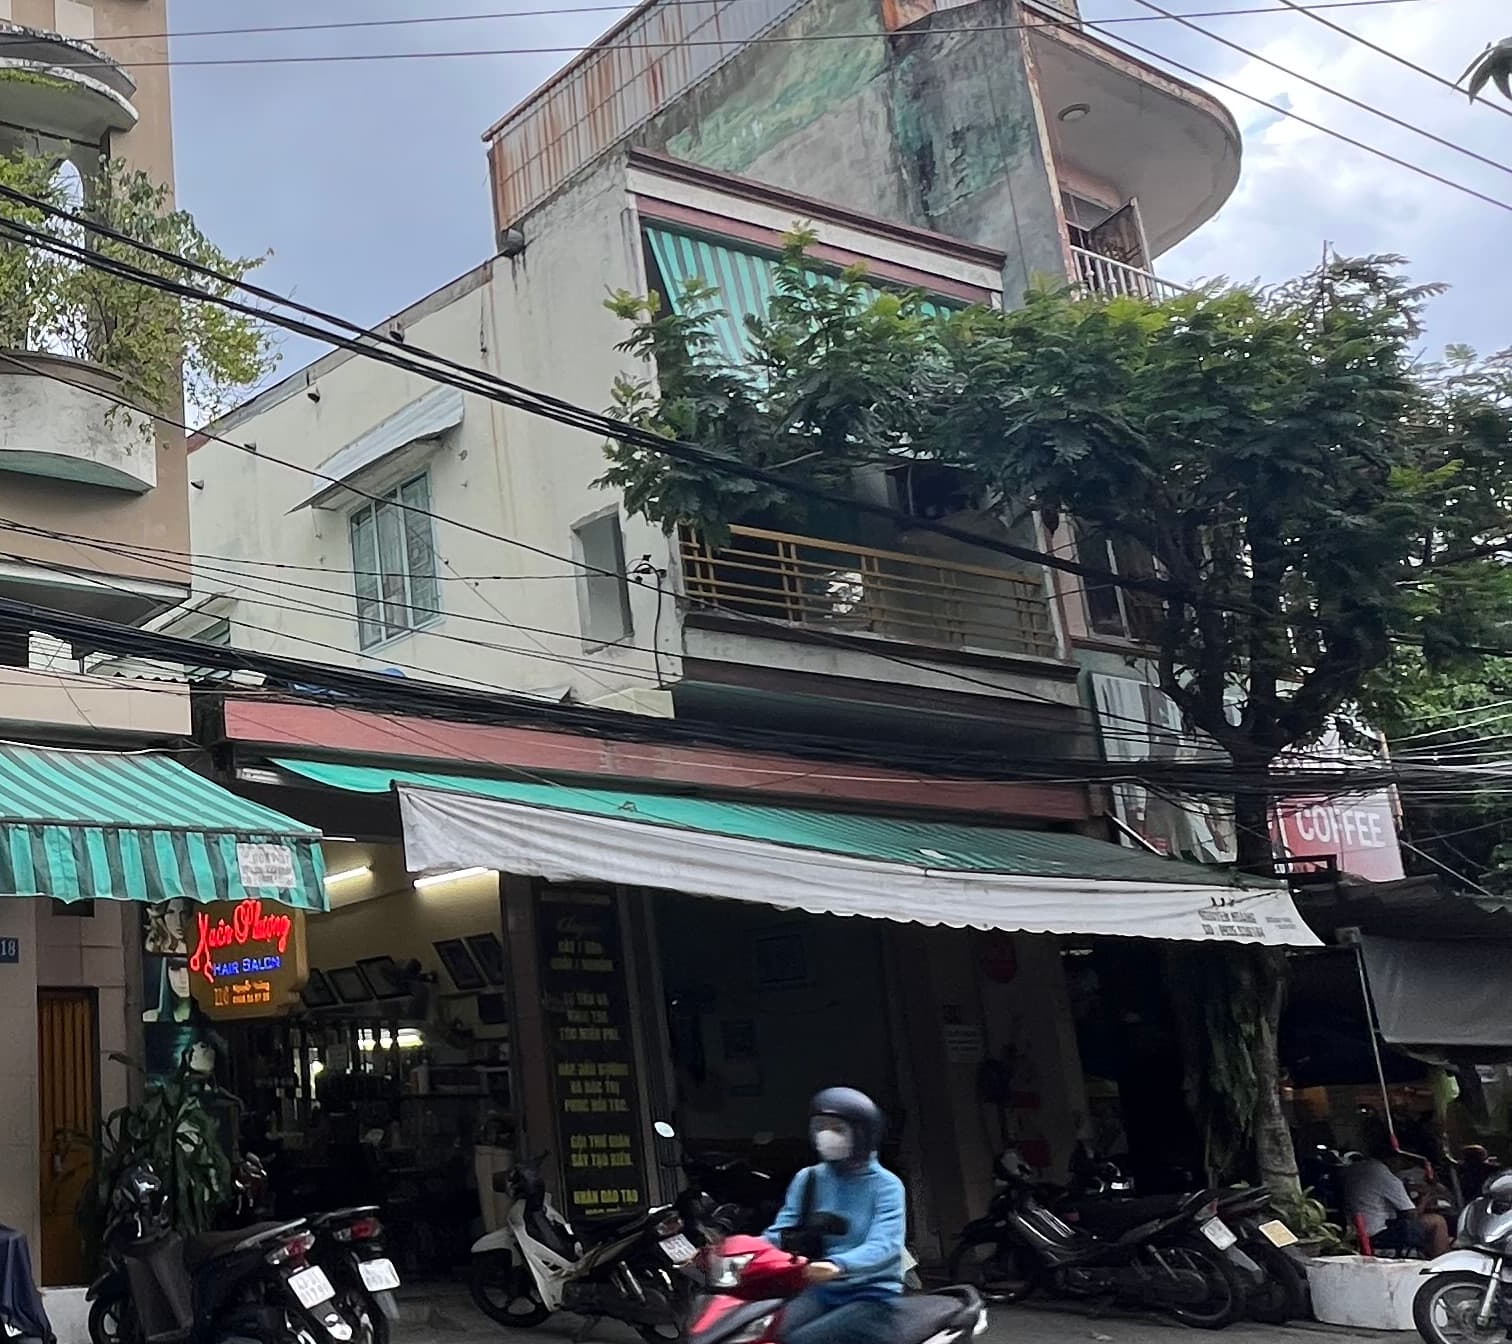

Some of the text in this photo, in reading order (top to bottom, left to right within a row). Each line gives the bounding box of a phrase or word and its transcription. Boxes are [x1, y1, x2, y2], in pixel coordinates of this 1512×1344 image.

[1295, 805, 1386, 847] COFFEE
[213, 955, 281, 977] HAIR SALON
